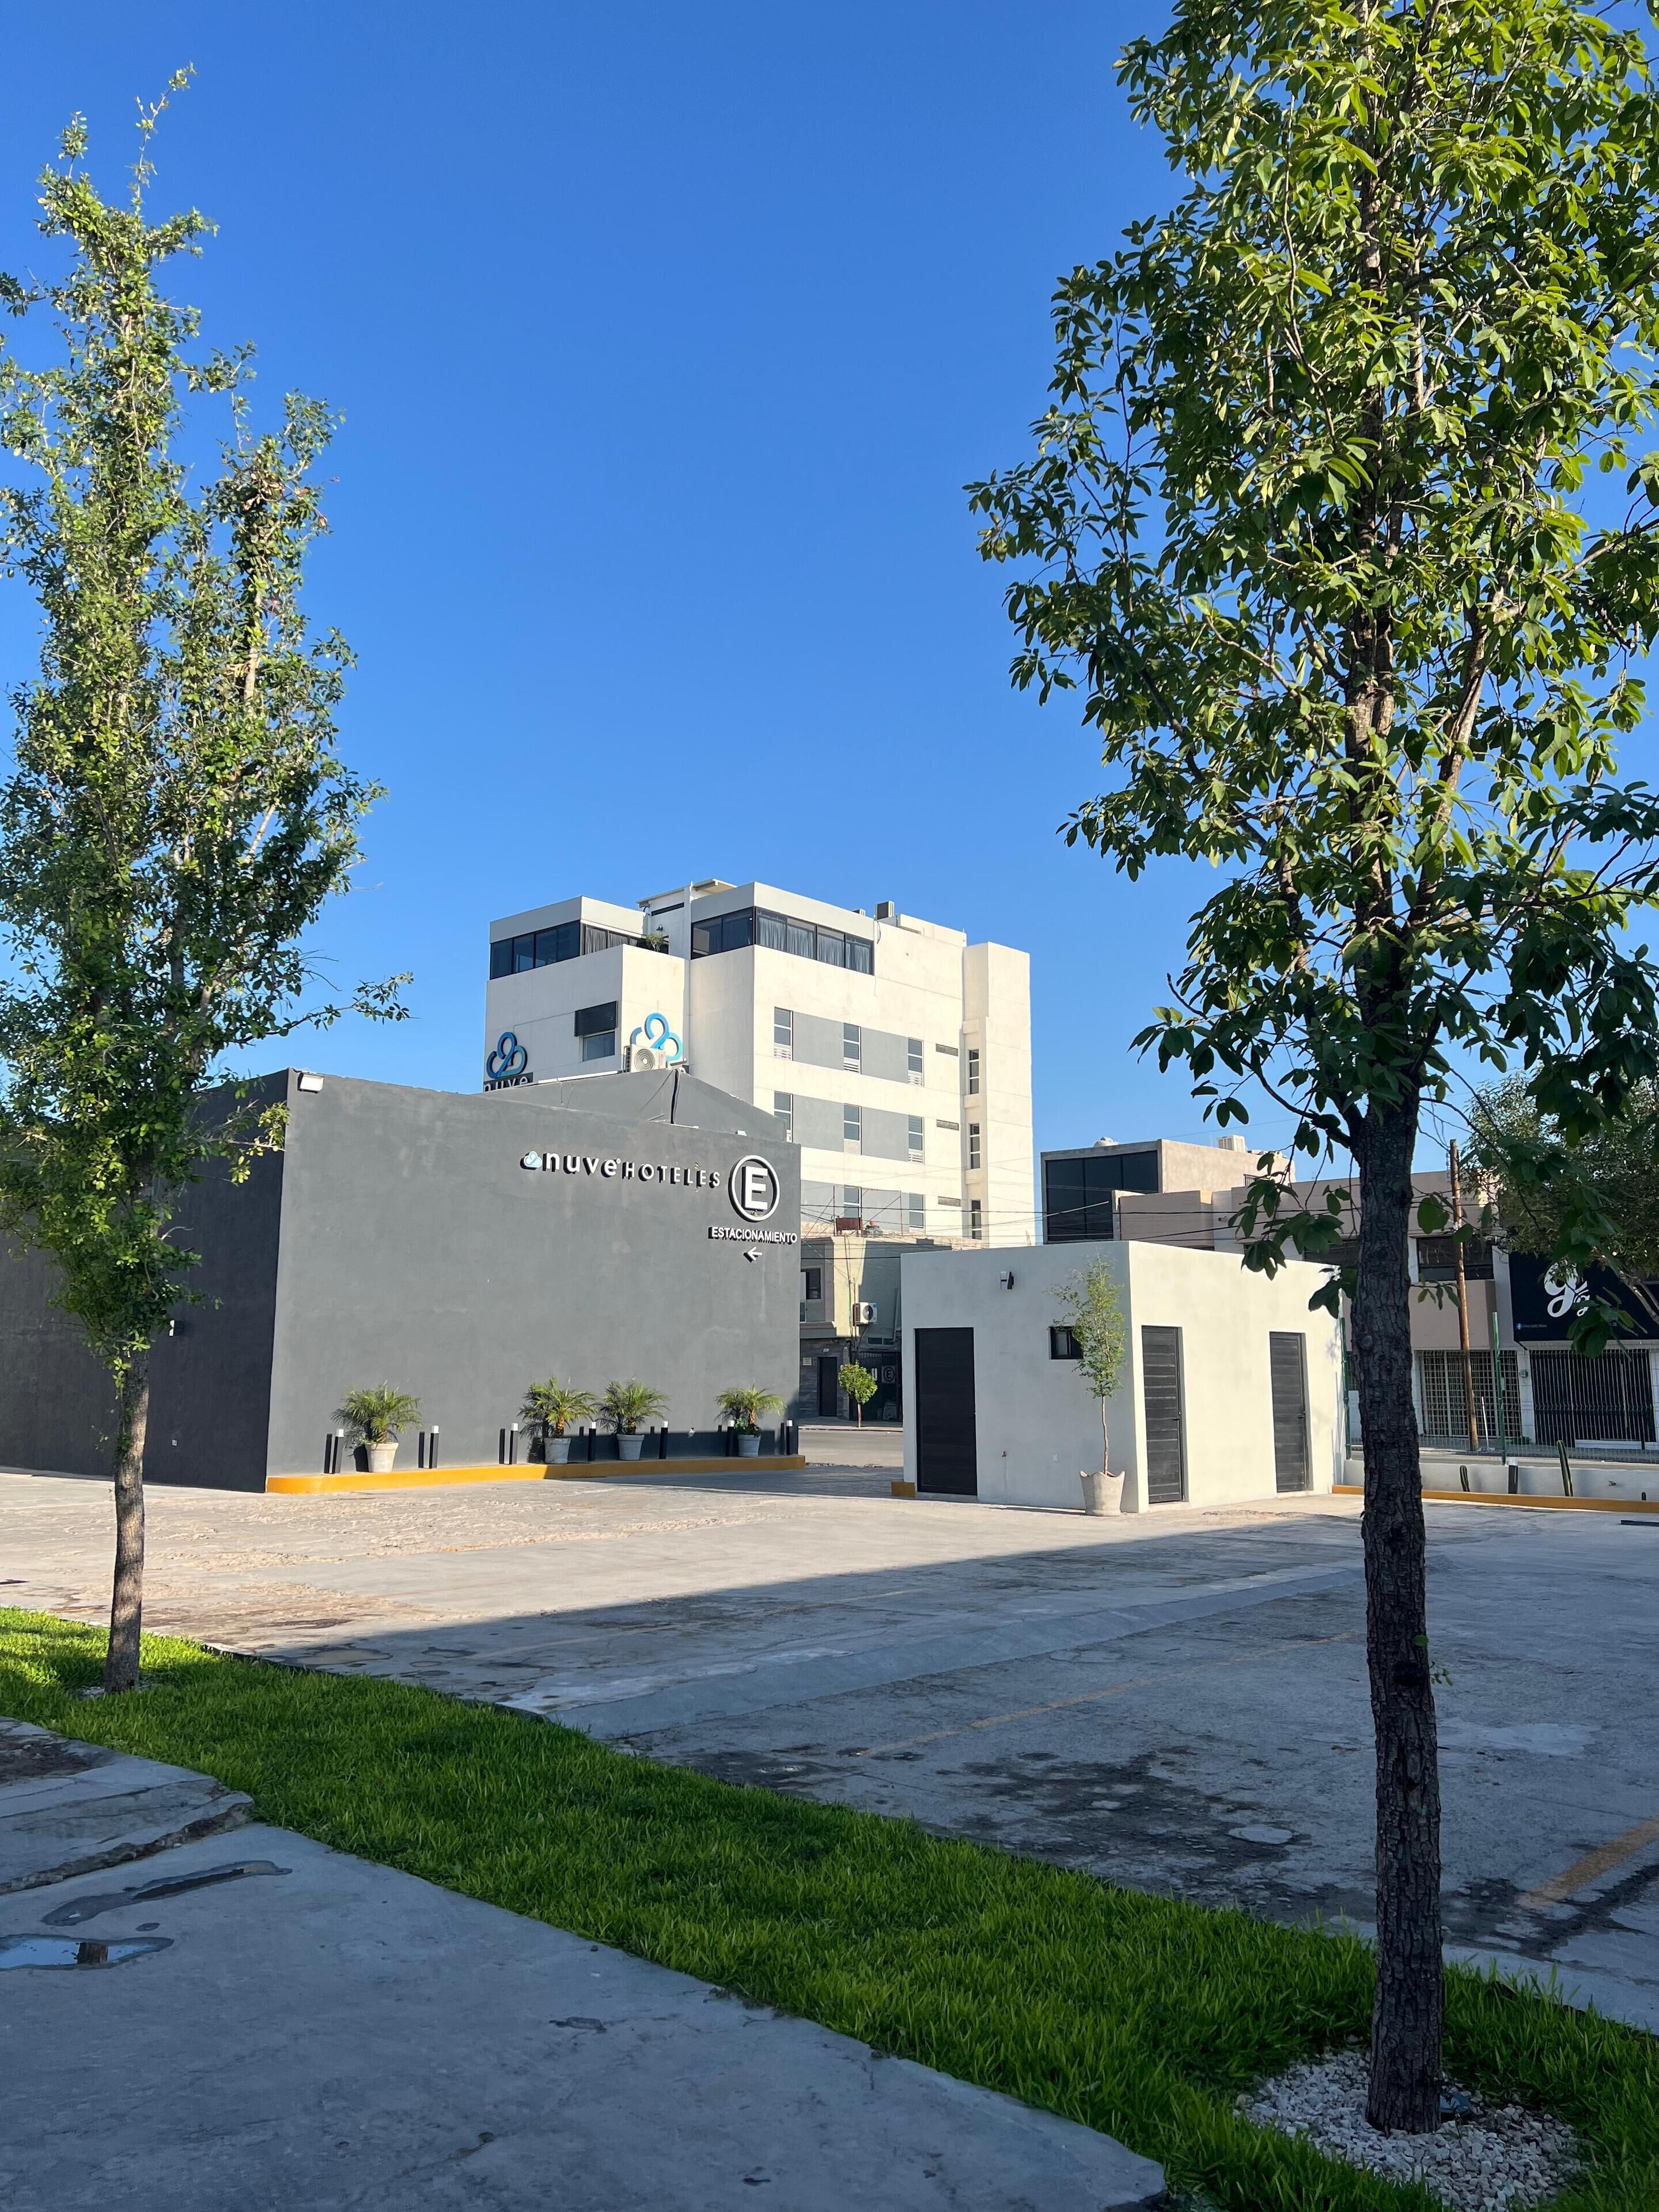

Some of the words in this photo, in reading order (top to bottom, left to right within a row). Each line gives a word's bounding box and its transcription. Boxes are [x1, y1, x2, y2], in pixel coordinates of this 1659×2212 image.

[625, 1161, 721, 1188] HOTELES
[744, 1166, 768, 1210] E
[711, 1226, 798, 1244] ESTACIONAMIENTO
